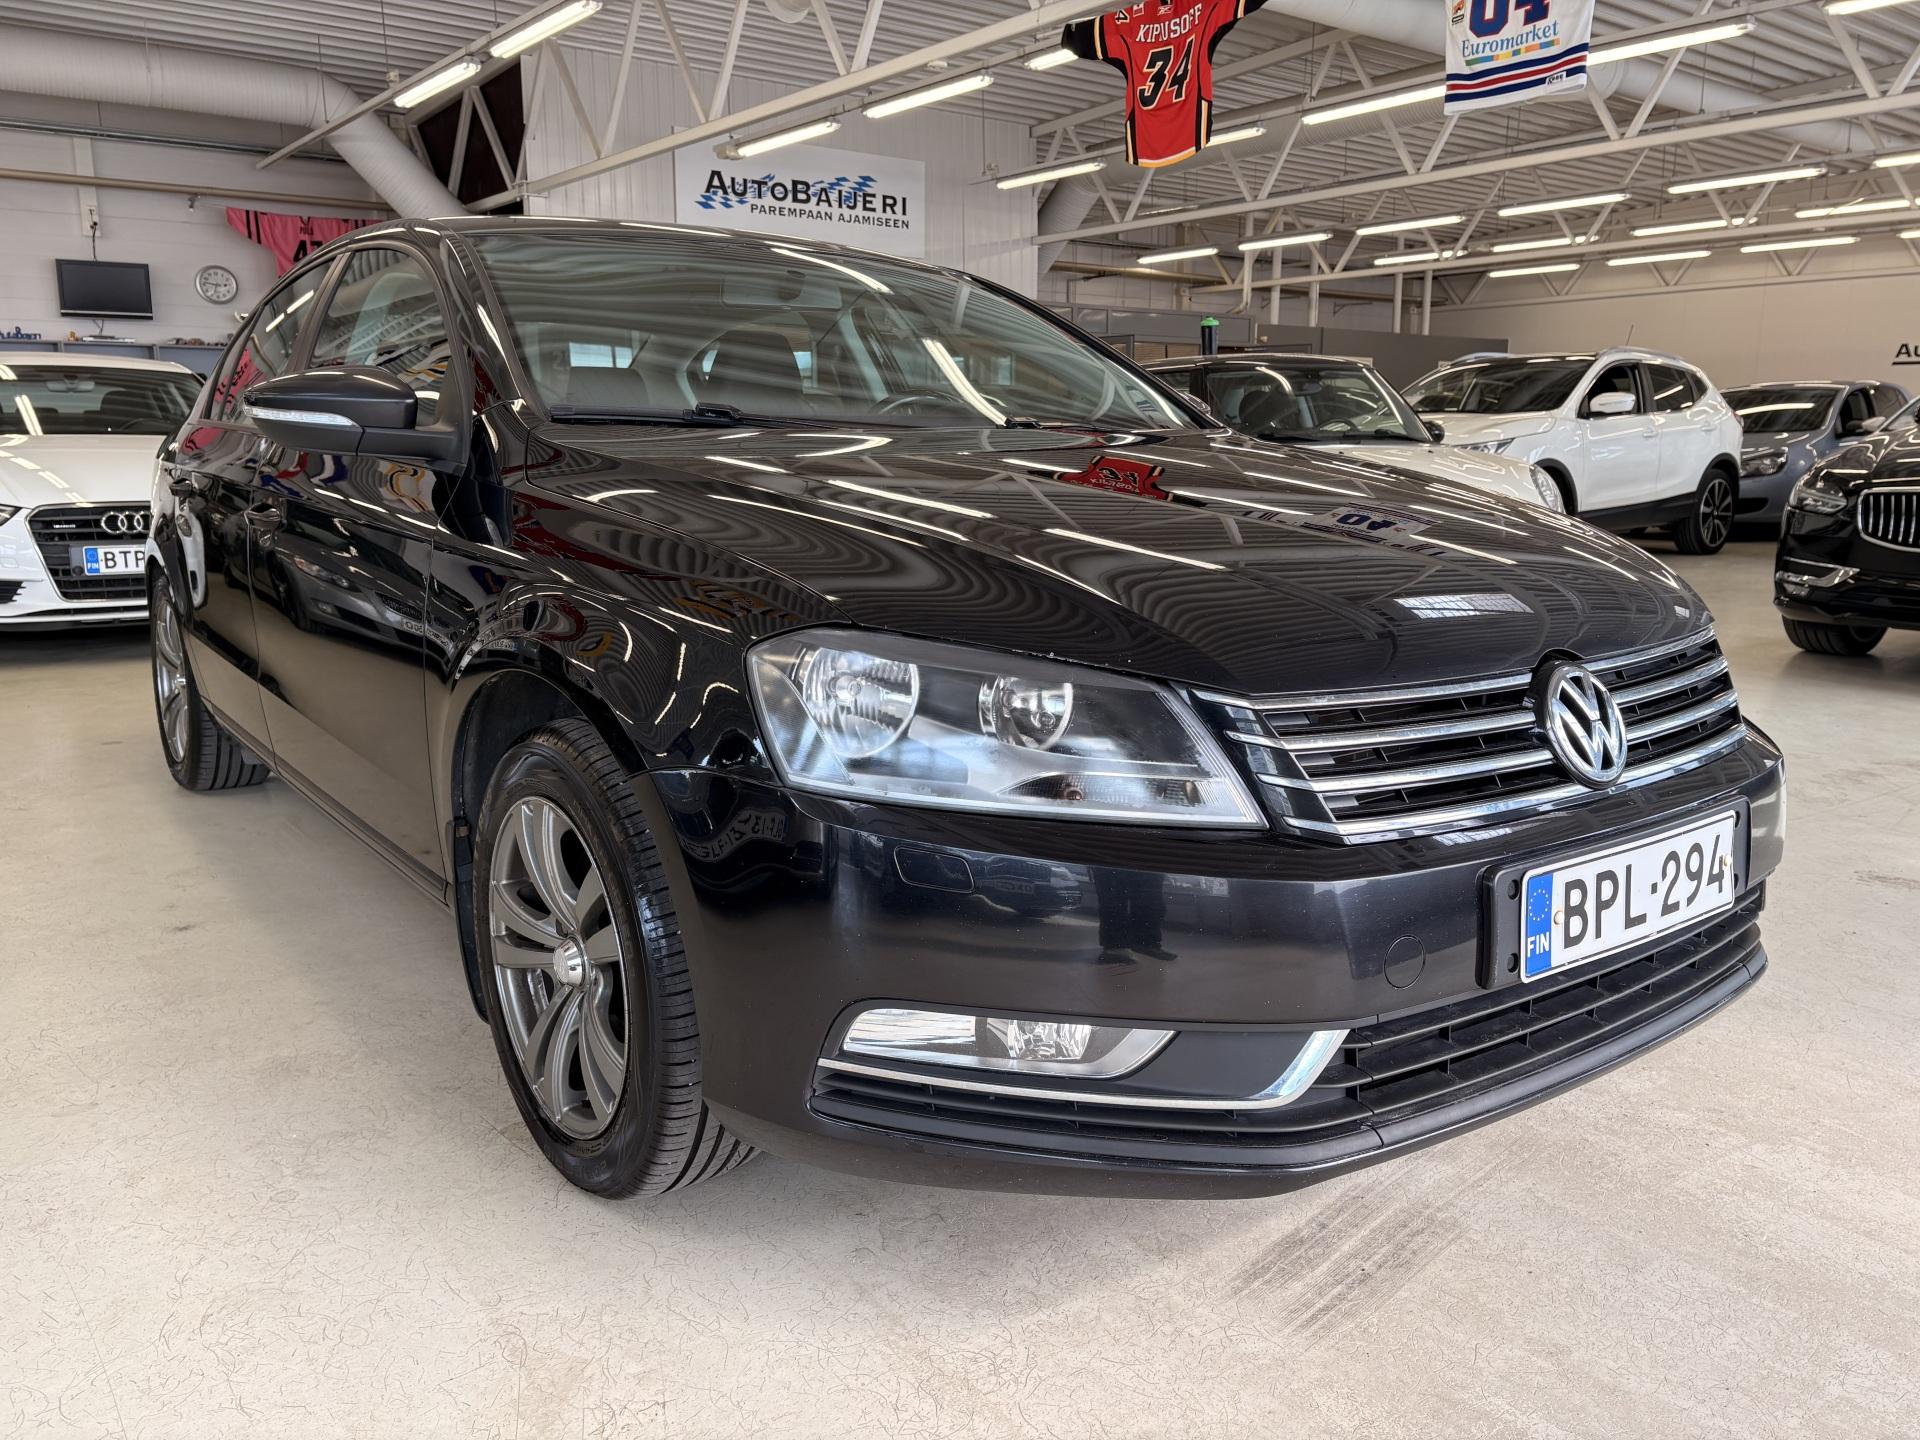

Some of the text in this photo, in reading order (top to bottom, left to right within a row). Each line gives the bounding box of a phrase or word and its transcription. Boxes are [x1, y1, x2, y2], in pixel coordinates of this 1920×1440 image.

[1462, 20, 1559, 57] Euromarket
[1137, 34, 1196, 110] 34
[750, 203, 910, 229] PAREMPAAN AJAMISEEN
[103, 551, 145, 570] BTP
[1527, 932, 1550, 957] FIN
